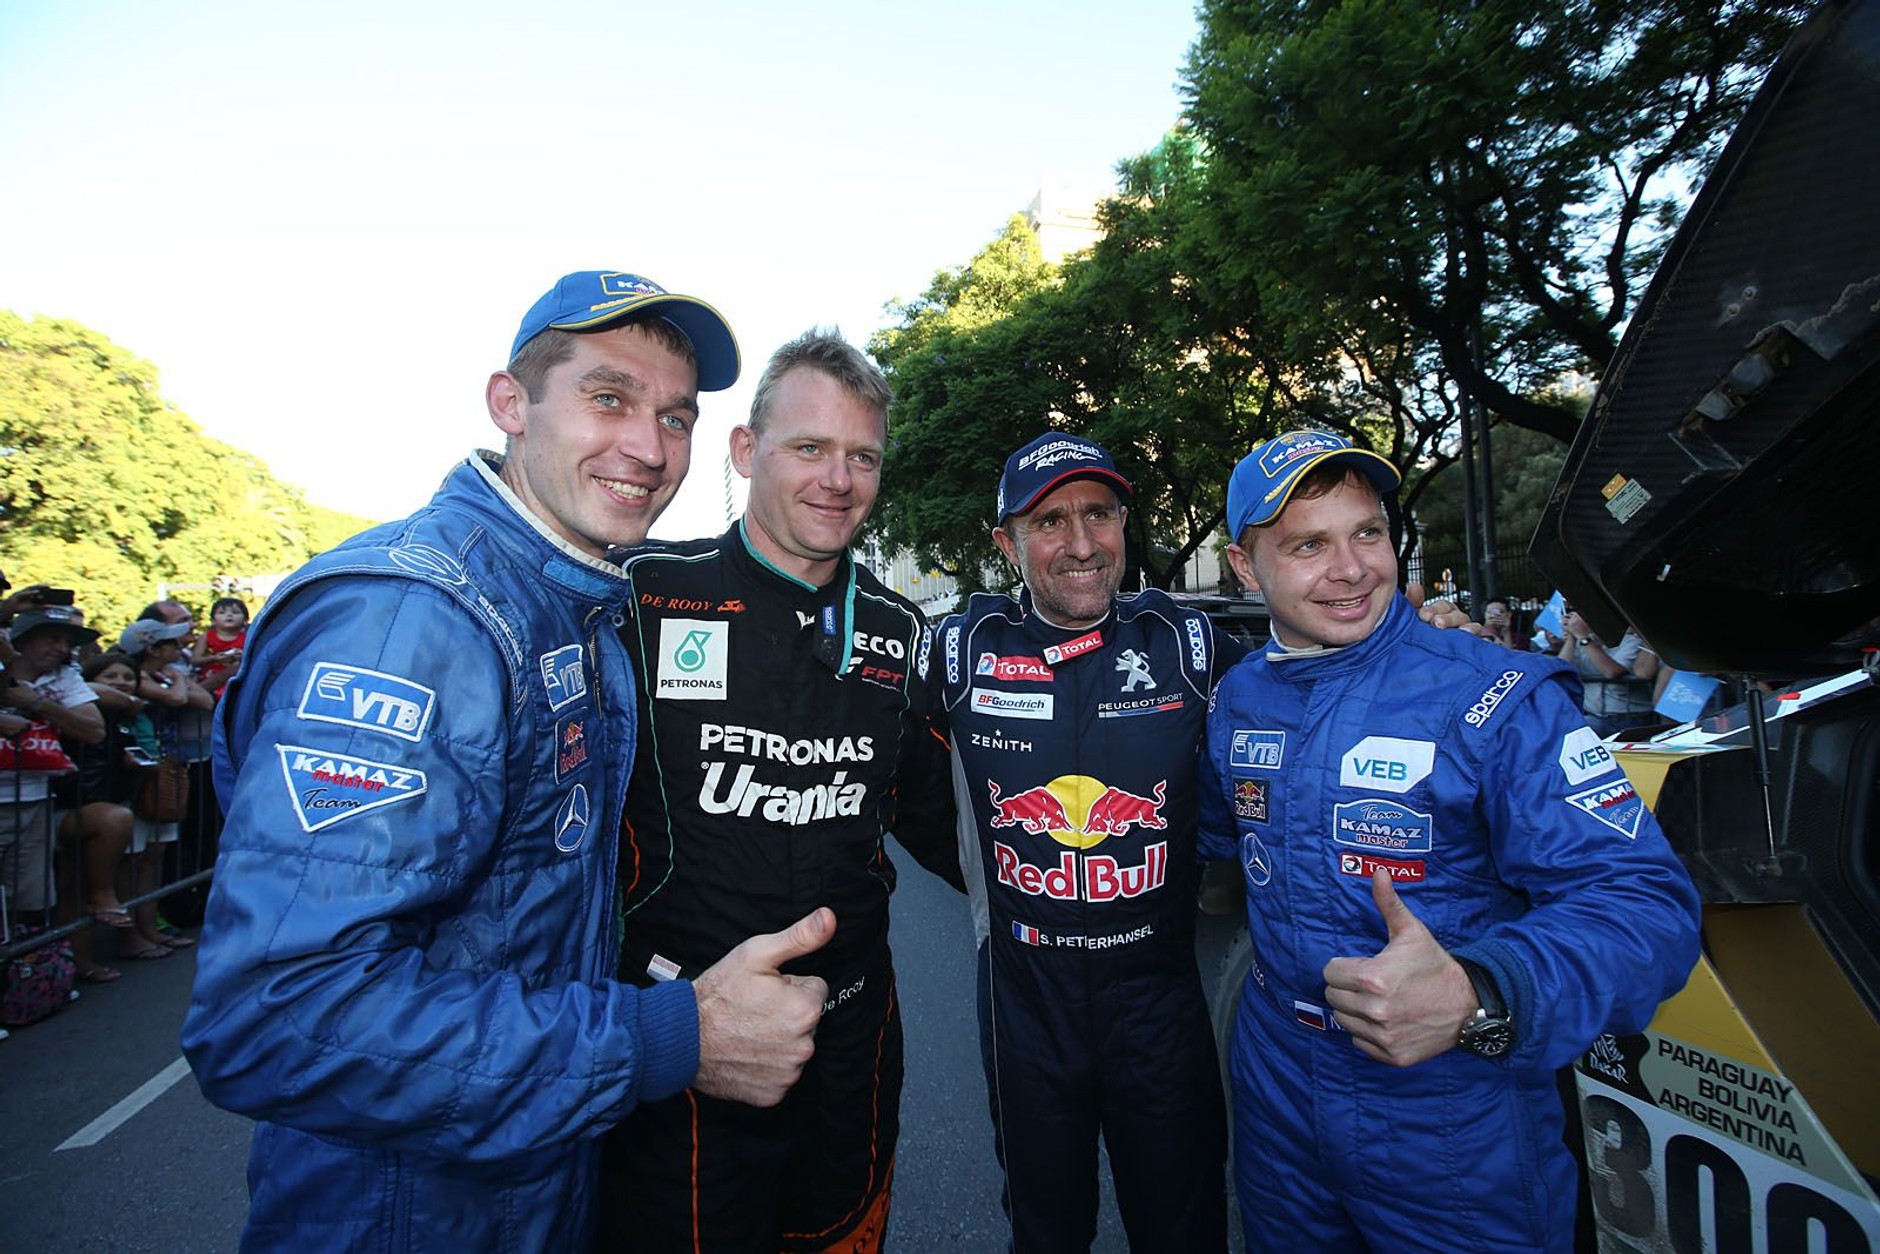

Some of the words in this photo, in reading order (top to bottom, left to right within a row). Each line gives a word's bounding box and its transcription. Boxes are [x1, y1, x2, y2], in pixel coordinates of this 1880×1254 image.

[1035, 450, 1097, 471] RACING
[1271, 440, 1337, 464] KAMAZ
[641, 593, 664, 607] DE
[667, 598, 713, 611] ROOY
[853, 631, 905, 660] ECO
[945, 626, 960, 684] sparco
[1060, 637, 1100, 655] TOTAL
[1185, 618, 1206, 671] sparco
[560, 661, 586, 697] VTB
[861, 666, 904, 686] FPT
[997, 661, 1051, 676] TOTAL
[660, 679, 723, 689] PETRONAS
[353, 687, 422, 732] VTB
[978, 694, 1045, 709] BFGoodrich
[1098, 698, 1156, 711] PEUGEOT
[1157, 692, 1184, 704] SPORT
[1464, 670, 1524, 728] sparco
[700, 723, 874, 766] PETRONAS
[971, 733, 1032, 753] ZENITH
[1247, 742, 1280, 765] VTB
[1353, 757, 1408, 781] VEB
[1569, 745, 1610, 770] VEB
[292, 754, 413, 790] KAMAZ
[312, 769, 386, 792] master
[303, 788, 362, 809] Team
[699, 762, 867, 826] Urania
[1583, 783, 1634, 810] KAM
[1235, 800, 1249, 816] Red
[1250, 802, 1266, 819] Bull
[1361, 804, 1403, 821] Team
[1340, 818, 1422, 838] KAMAZ
[1355, 833, 1409, 848] master
[994, 840, 1079, 900] Red
[1084, 841, 1168, 903] Bull
[1040, 934, 1053, 946] S.
[1056, 924, 1154, 950] PETERHANSEL
[1658, 1038, 1794, 1104] PARAGUAY
[1698, 1076, 1798, 1135] BOLIVIA
[1659, 1088, 1807, 1167] ARGENTINA
